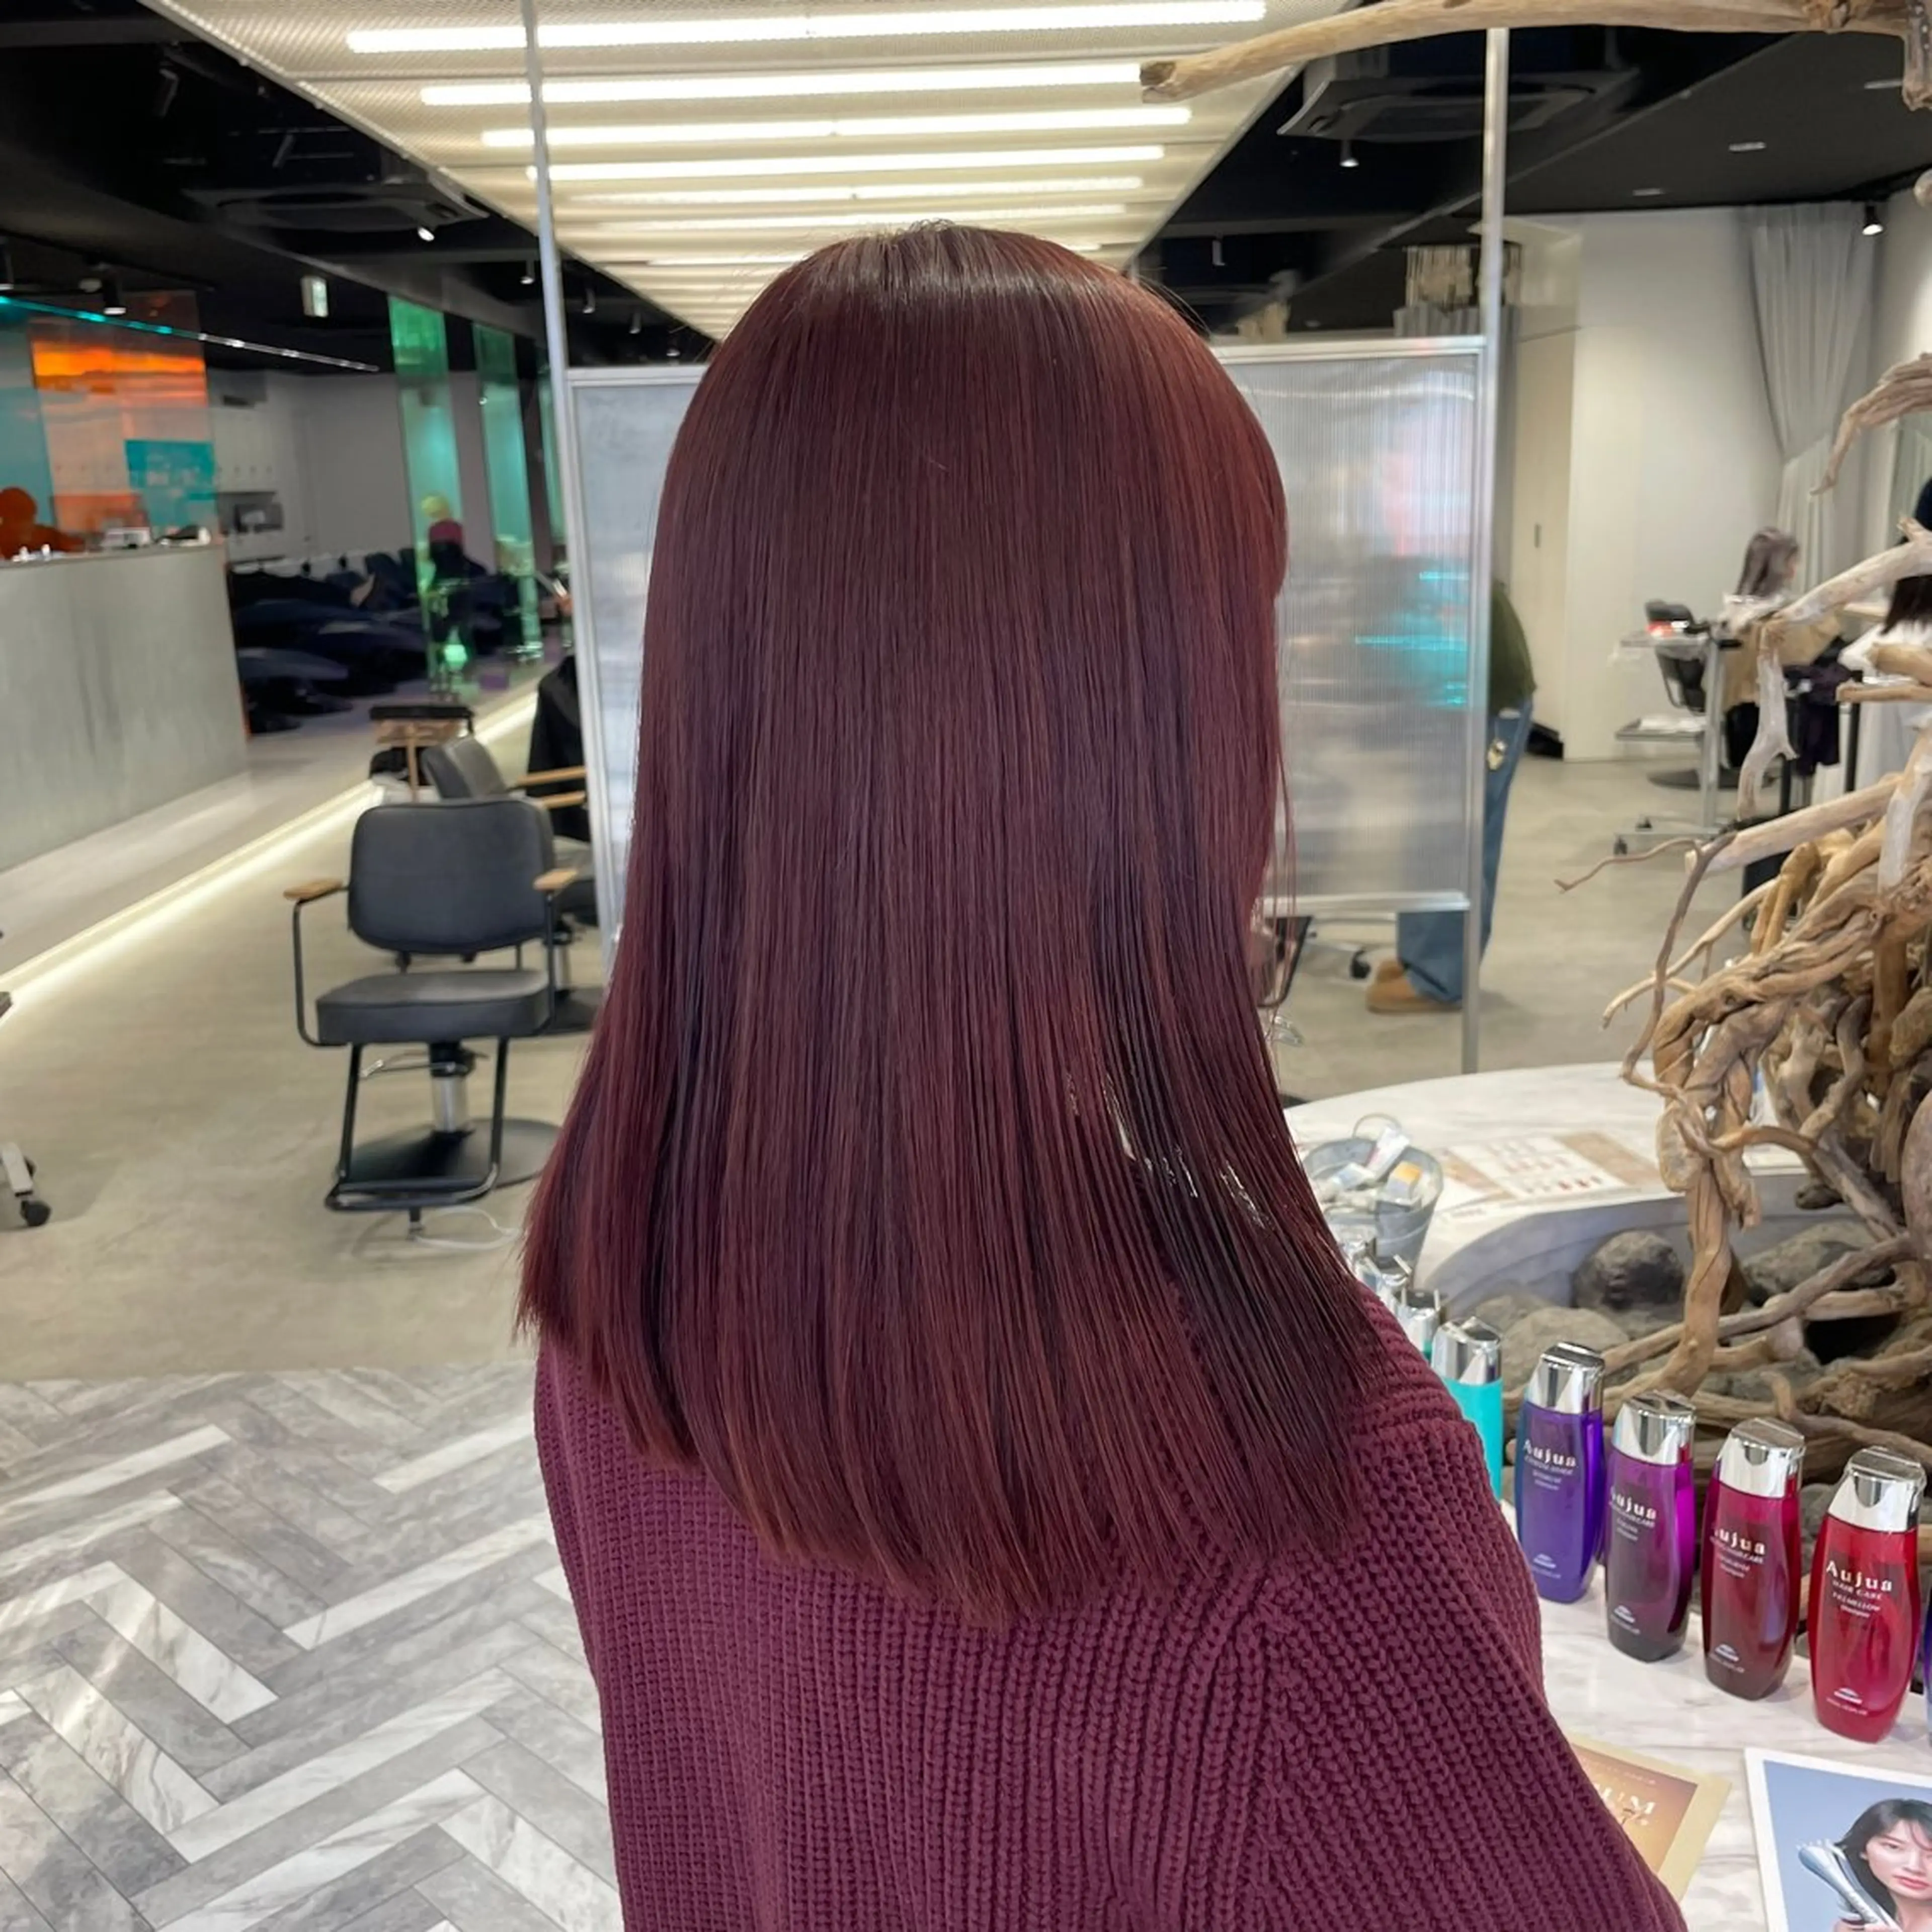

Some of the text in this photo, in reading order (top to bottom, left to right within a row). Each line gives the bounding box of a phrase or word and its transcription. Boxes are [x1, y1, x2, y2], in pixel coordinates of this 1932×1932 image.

[1523, 1439, 1576, 1467] Aujua
[1714, 1528, 1765, 1556] ujua
[1826, 1560, 1892, 1592] Aujua
